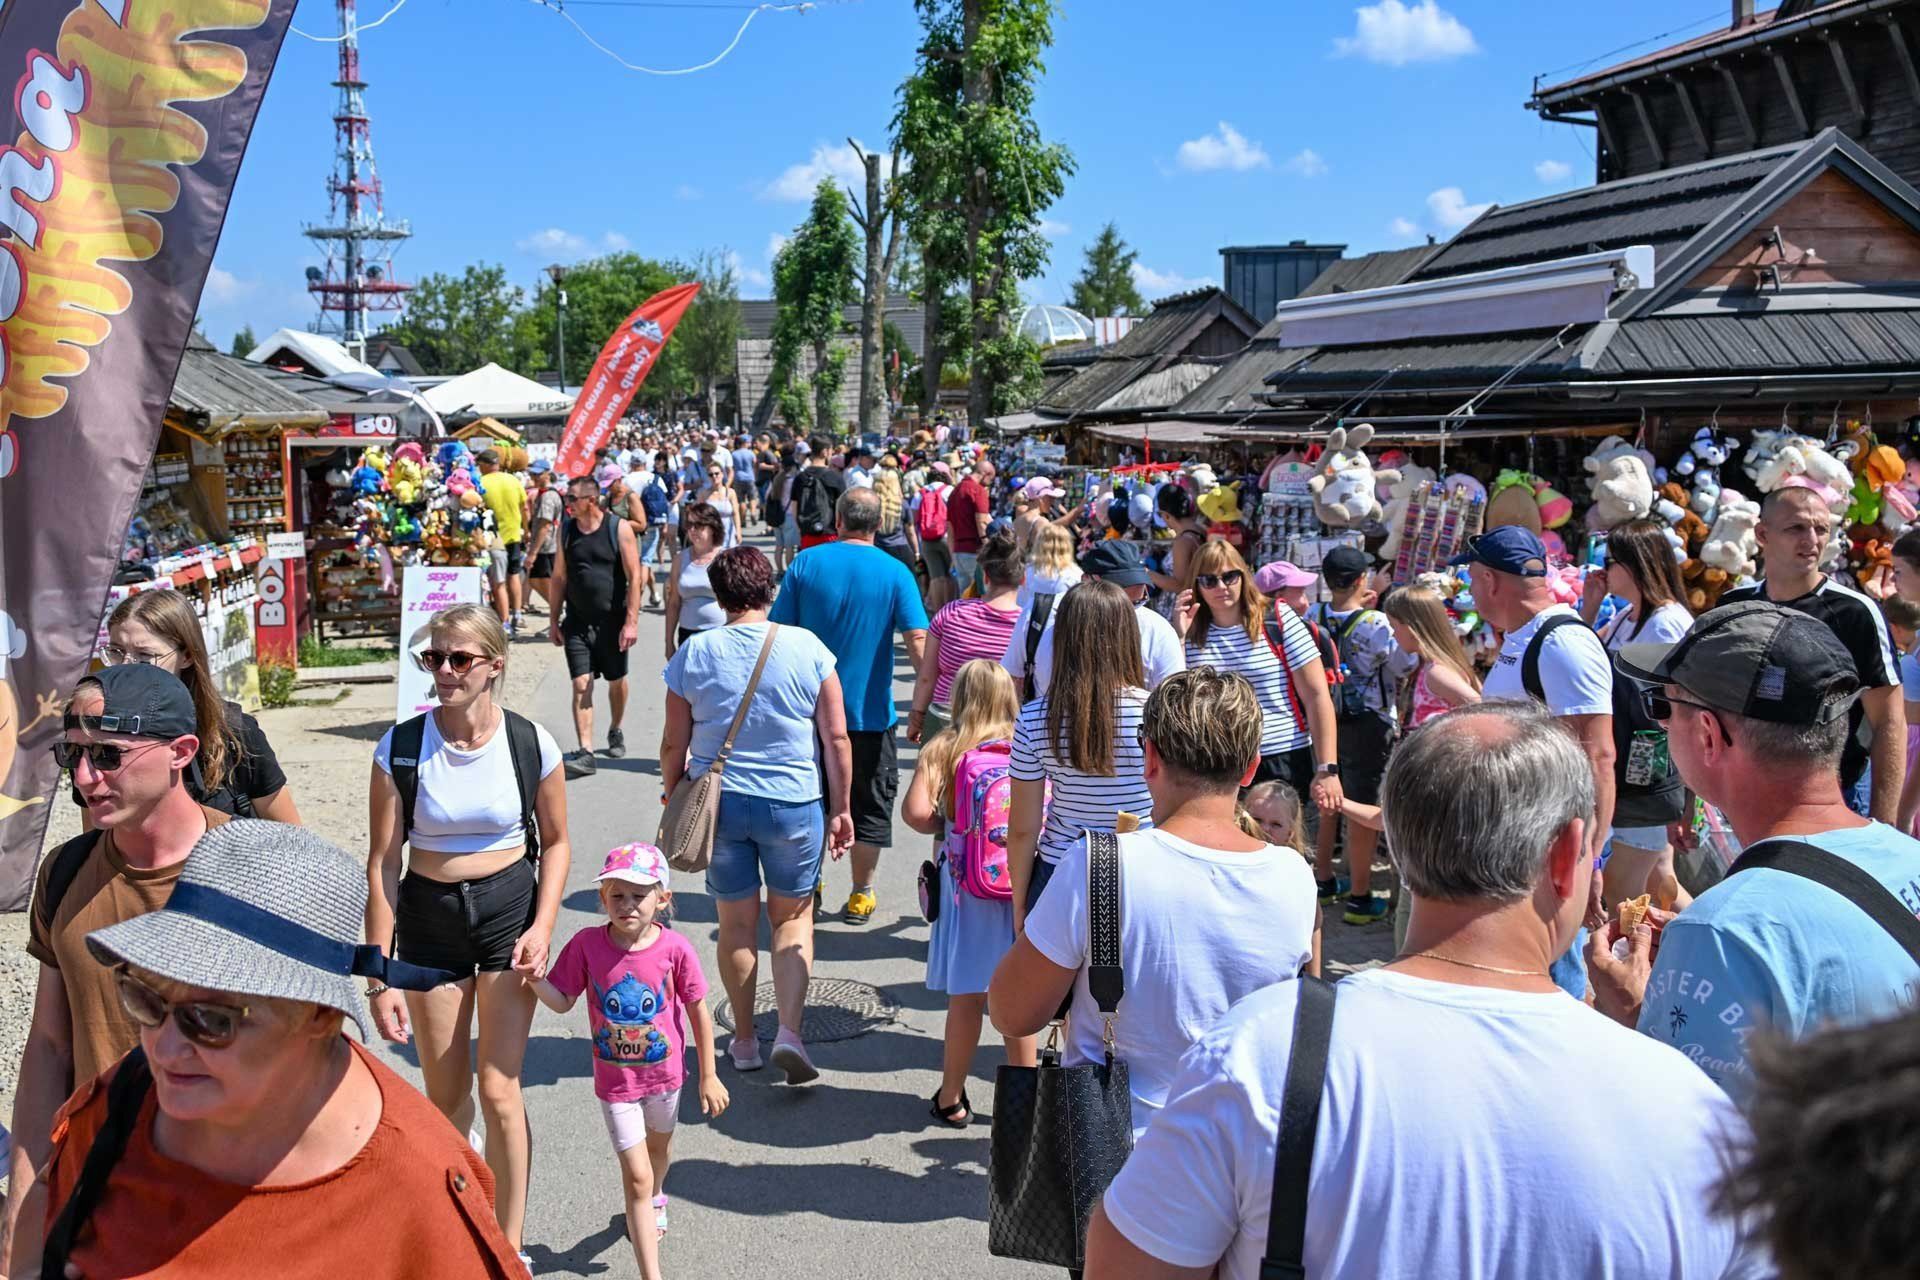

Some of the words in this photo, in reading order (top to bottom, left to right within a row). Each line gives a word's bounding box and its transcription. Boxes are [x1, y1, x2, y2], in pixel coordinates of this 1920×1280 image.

[528, 401, 567, 411] PEPSI
[557, 410, 588, 464] WYCIECZKI
[586, 373, 608, 411] QUADY
[580, 345, 651, 460] zakopane_quady
[257, 556, 287, 627] BOA
[615, 1043, 641, 1055] YOU
[616, 1029, 622, 1041] I
